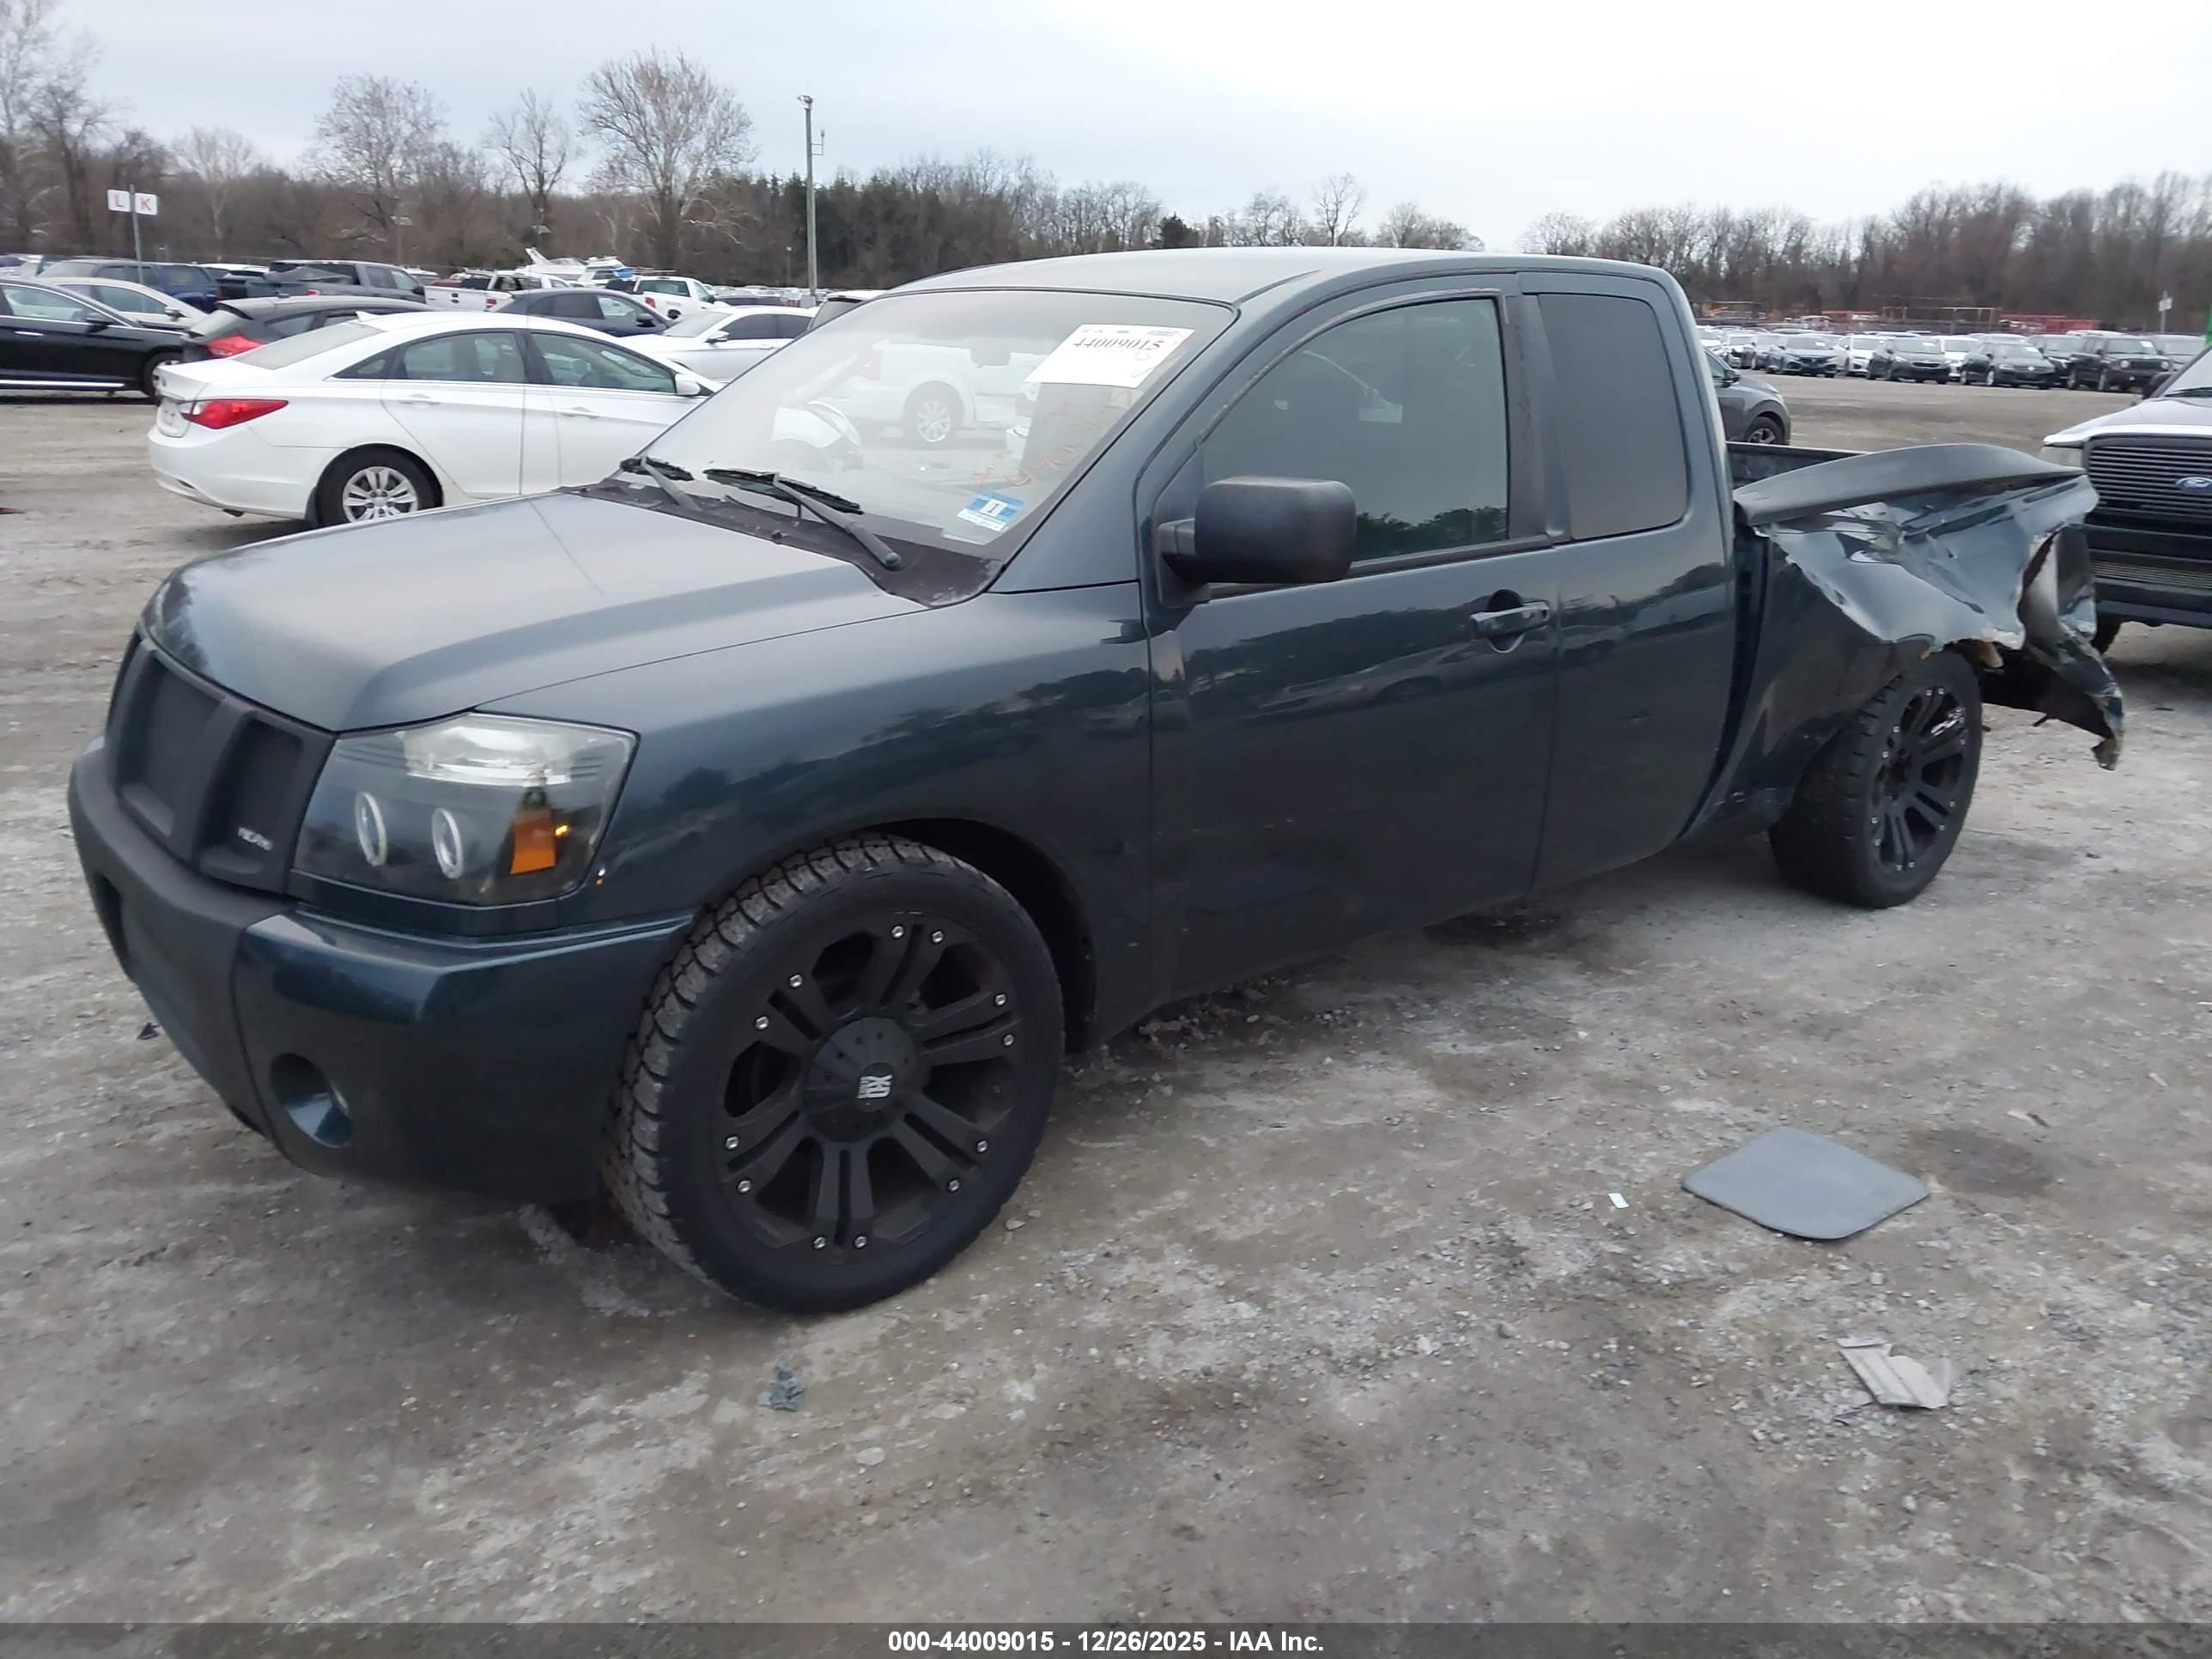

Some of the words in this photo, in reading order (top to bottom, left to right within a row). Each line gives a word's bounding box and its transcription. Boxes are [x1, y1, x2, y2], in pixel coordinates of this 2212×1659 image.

[114, 194, 125, 208] L
[140, 198, 152, 211] K
[1073, 337, 1165, 350] 44009015
